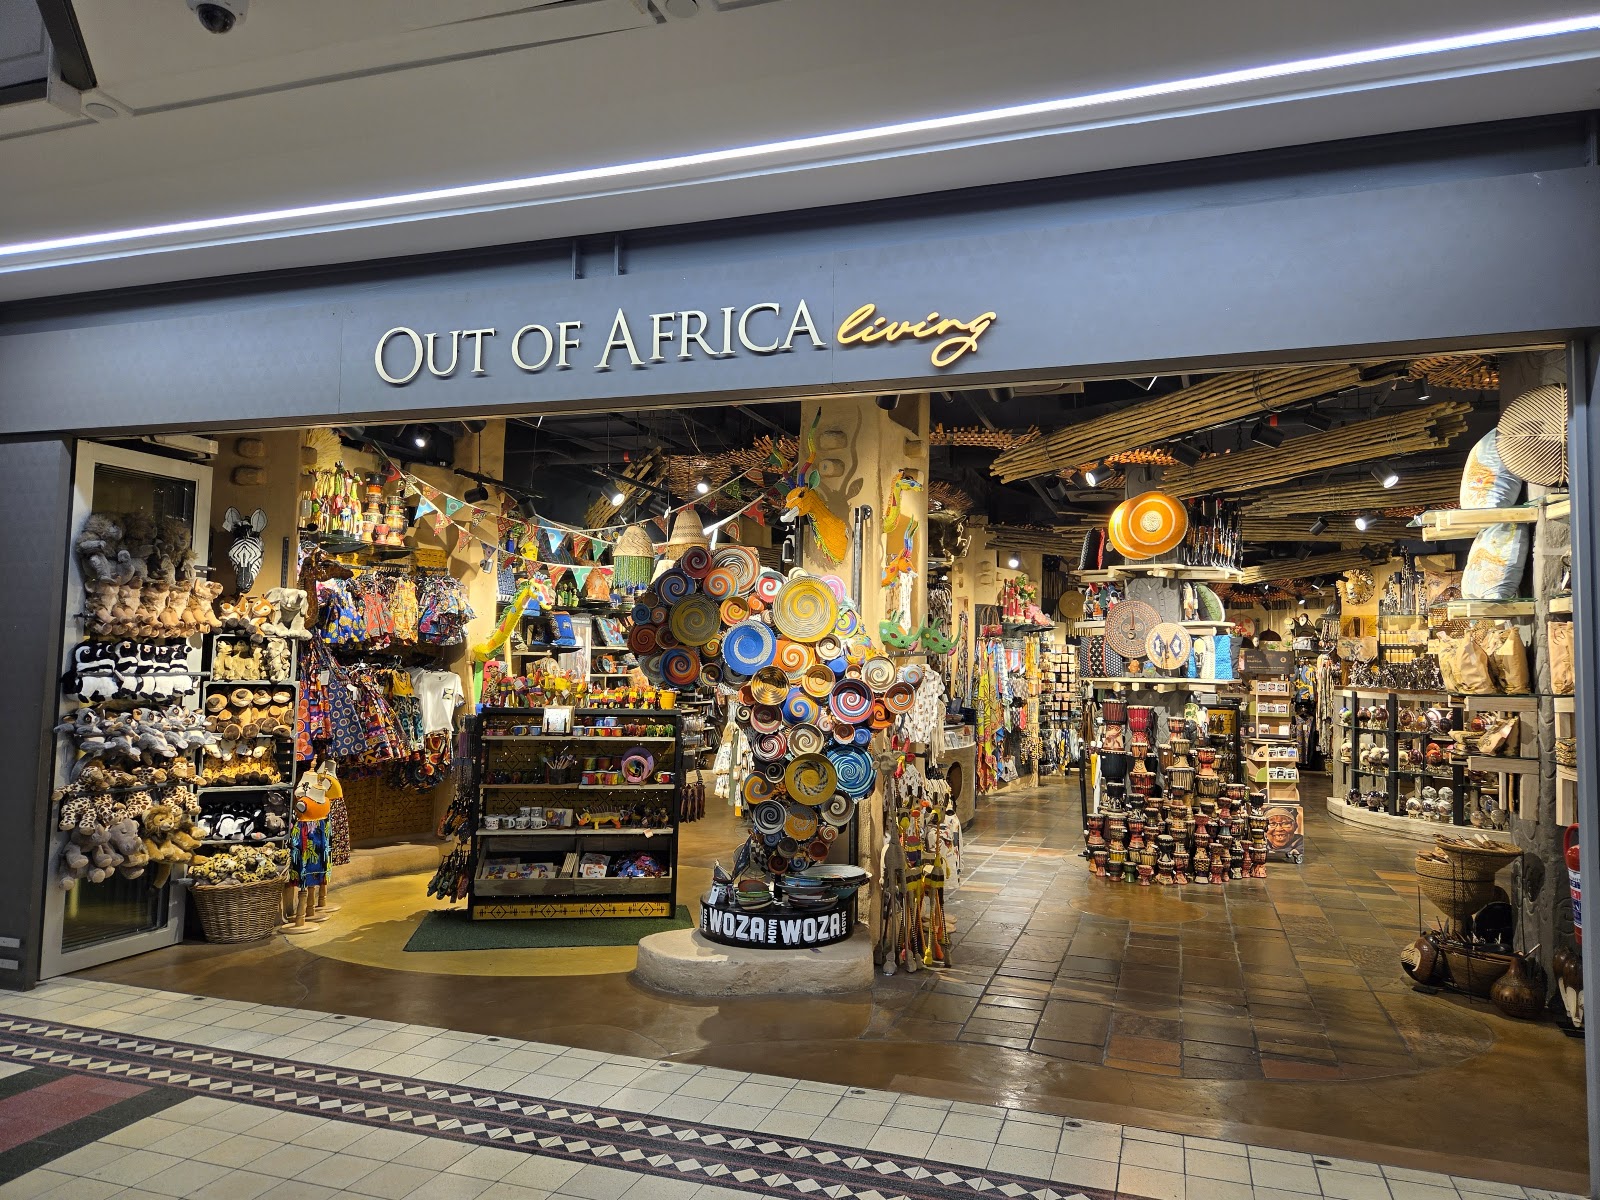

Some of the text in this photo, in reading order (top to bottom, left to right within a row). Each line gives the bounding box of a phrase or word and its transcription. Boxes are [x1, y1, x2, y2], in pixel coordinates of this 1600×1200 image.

[374, 298, 997, 384] OUT OF AFRICA living
[709, 907, 766, 943] WOZA
[768, 919, 778, 944] MOYA
[780, 912, 841, 946] WOZA
